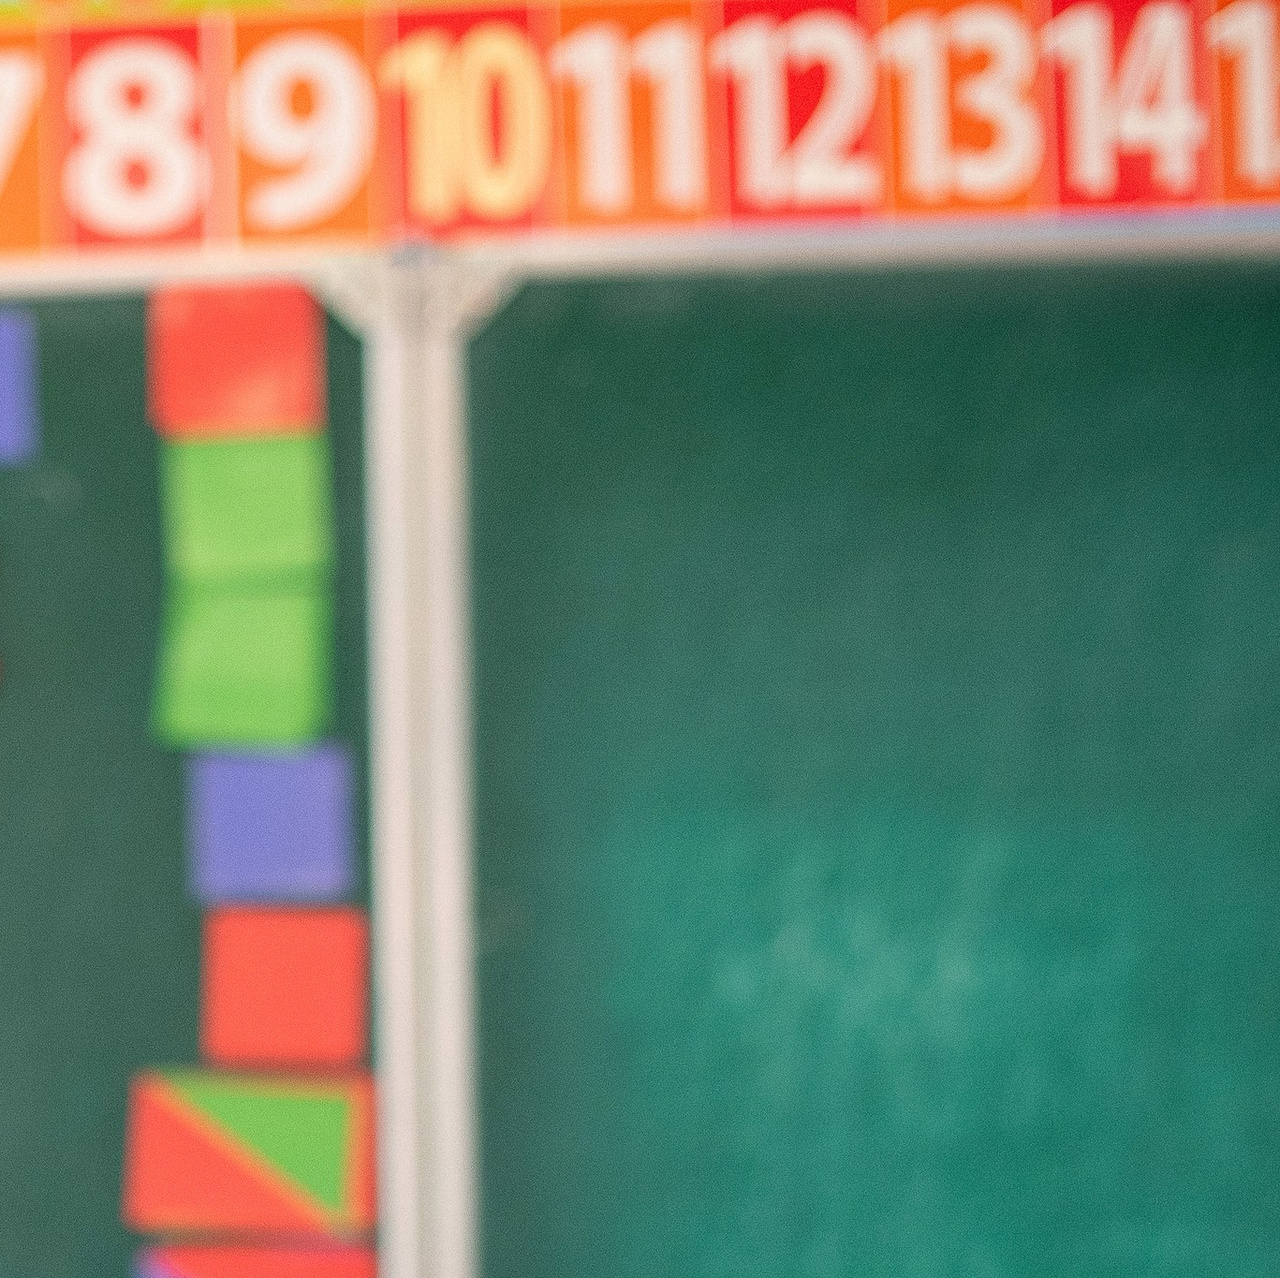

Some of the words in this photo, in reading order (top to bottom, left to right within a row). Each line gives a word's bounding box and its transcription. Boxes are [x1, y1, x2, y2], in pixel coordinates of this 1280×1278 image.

[61, 38, 211, 236] 8
[229, 31, 376, 230] 9
[379, 24, 551, 222] 10
[554, 20, 709, 215] 11
[713, 11, 882, 205] 12
[879, 5, 1042, 199] 13
[1038, 3, 1208, 193] 14
[1204, 2, 1280, 187] 1
